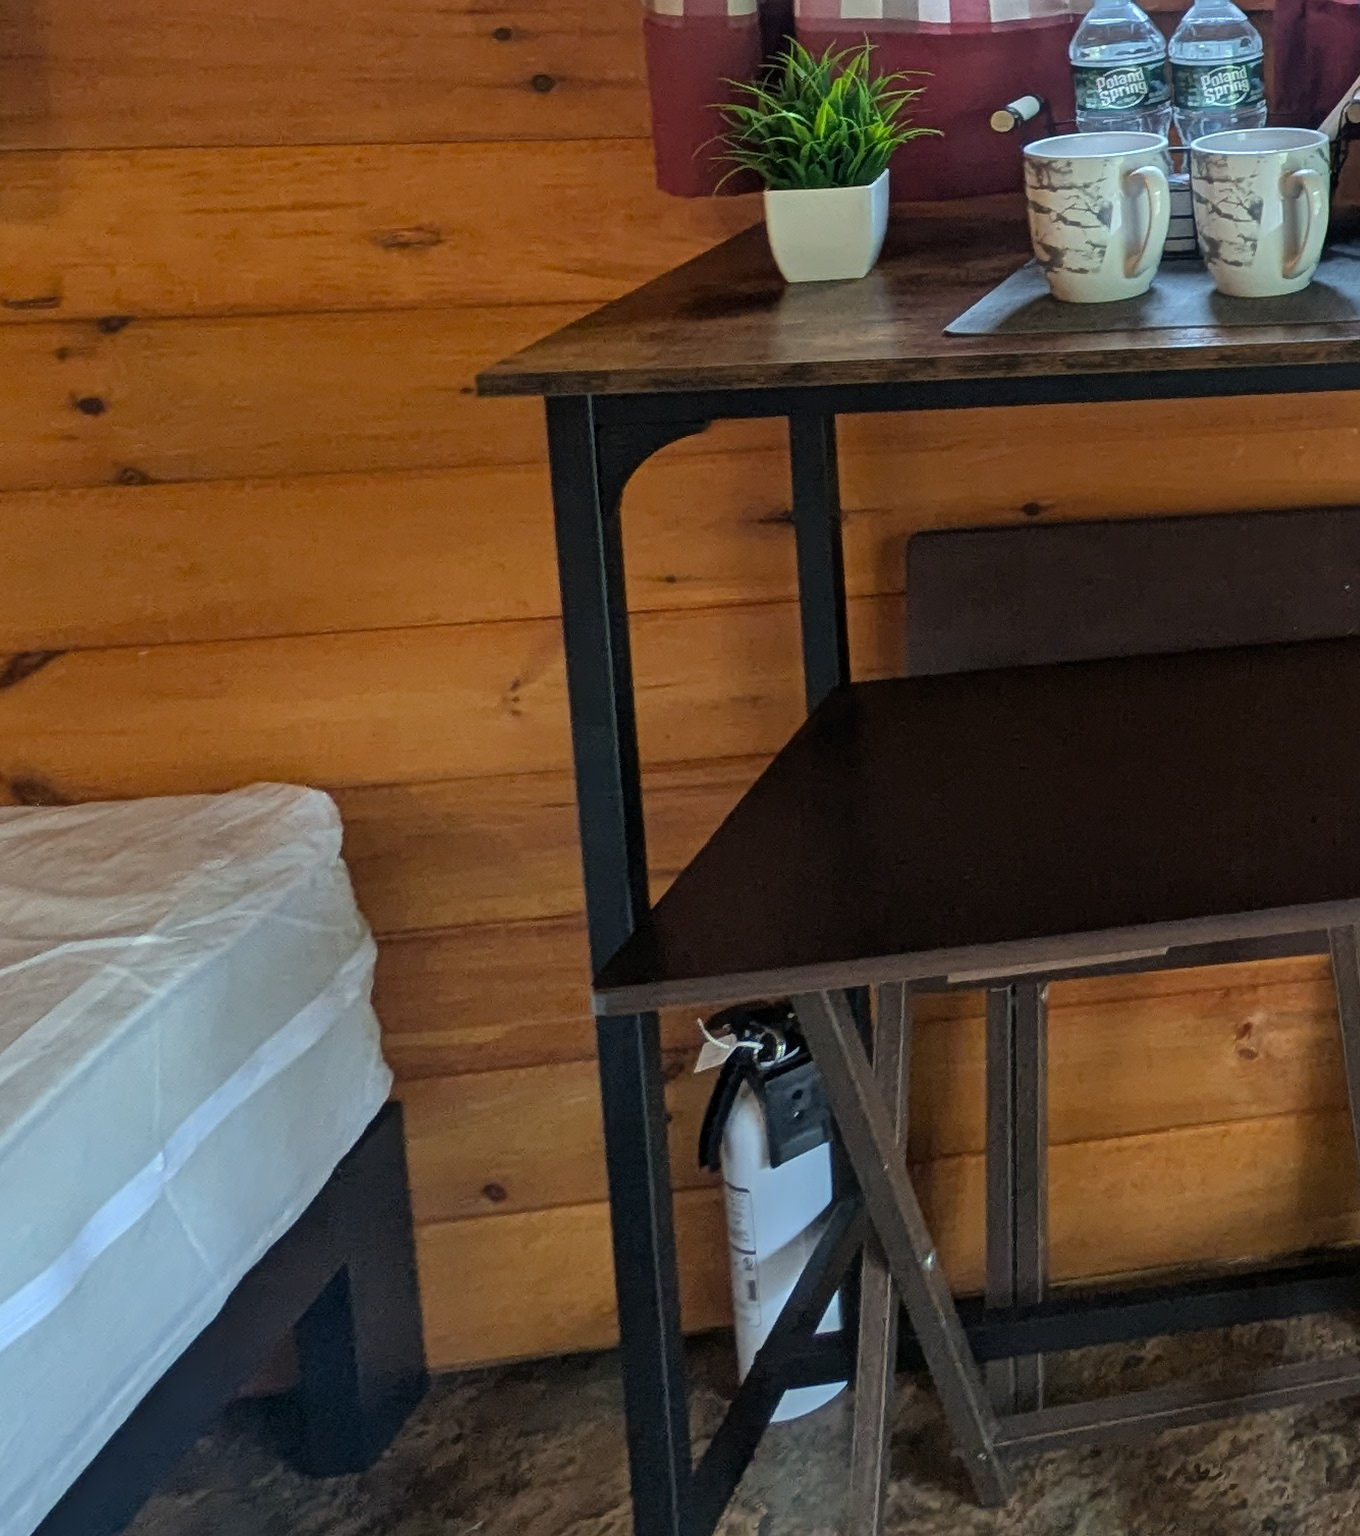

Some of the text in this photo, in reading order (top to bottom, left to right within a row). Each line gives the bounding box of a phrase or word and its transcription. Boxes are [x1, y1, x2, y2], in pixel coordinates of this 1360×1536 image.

[1096, 67, 1145, 92] Poland
[1200, 65, 1248, 91] Poland
[1099, 80, 1148, 106] Spring
[1203, 78, 1250, 105] Spring
